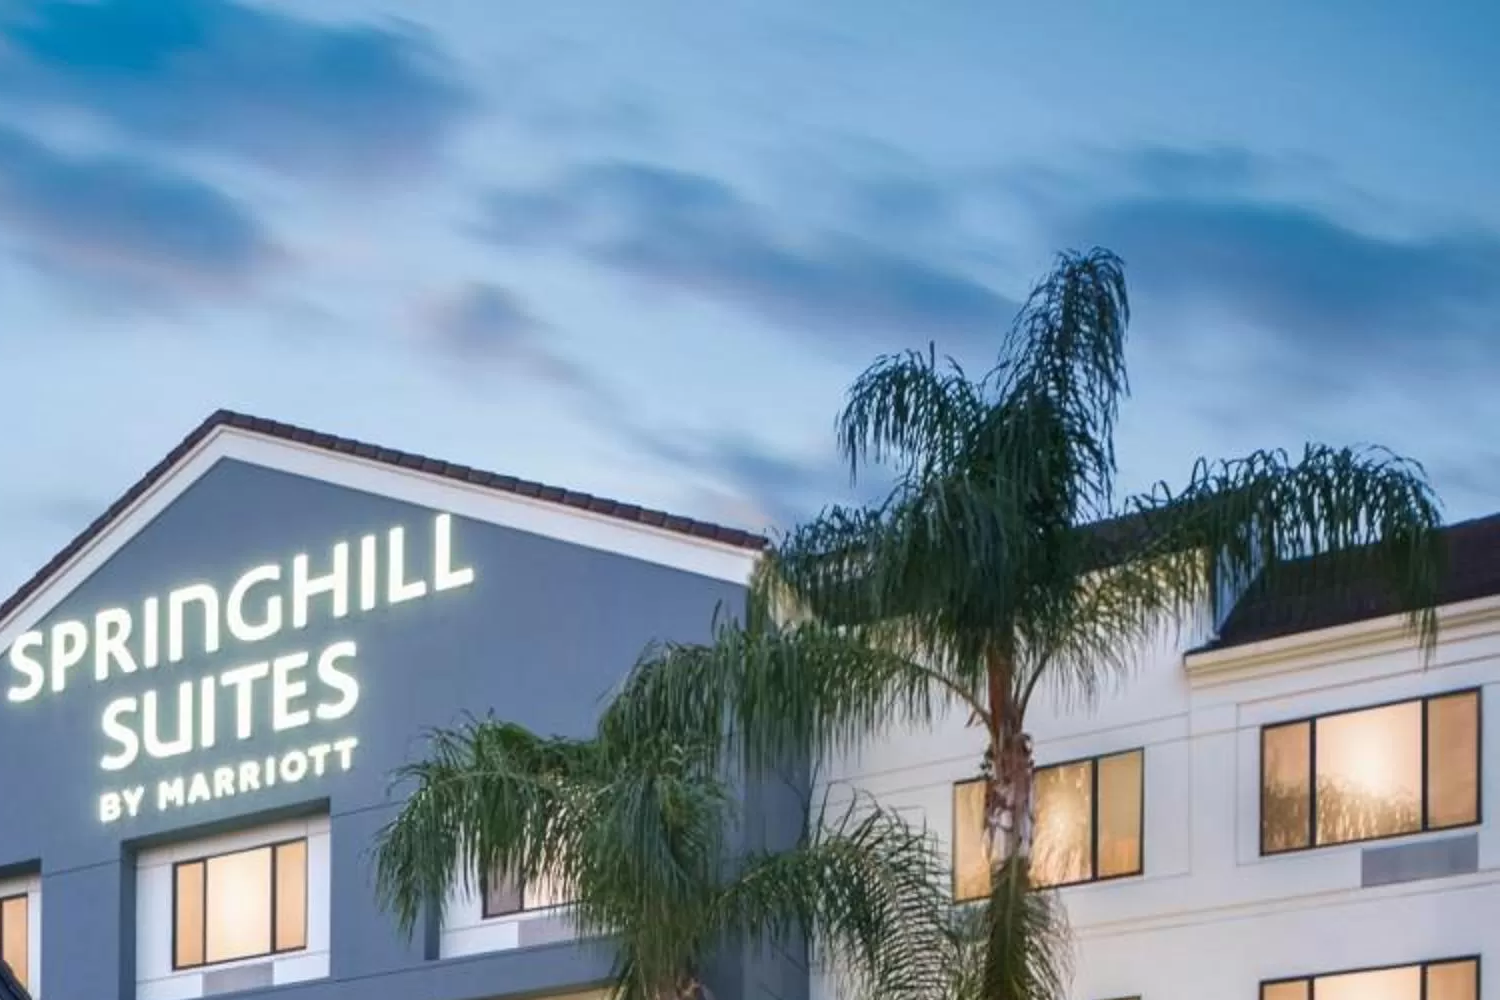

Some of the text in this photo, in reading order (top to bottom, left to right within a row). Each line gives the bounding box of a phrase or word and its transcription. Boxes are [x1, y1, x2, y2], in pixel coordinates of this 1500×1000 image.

[7, 513, 474, 702] SPRINGHILL
[100, 640, 360, 771] SUITES
[99, 737, 359, 823] BY MARRIOTT
